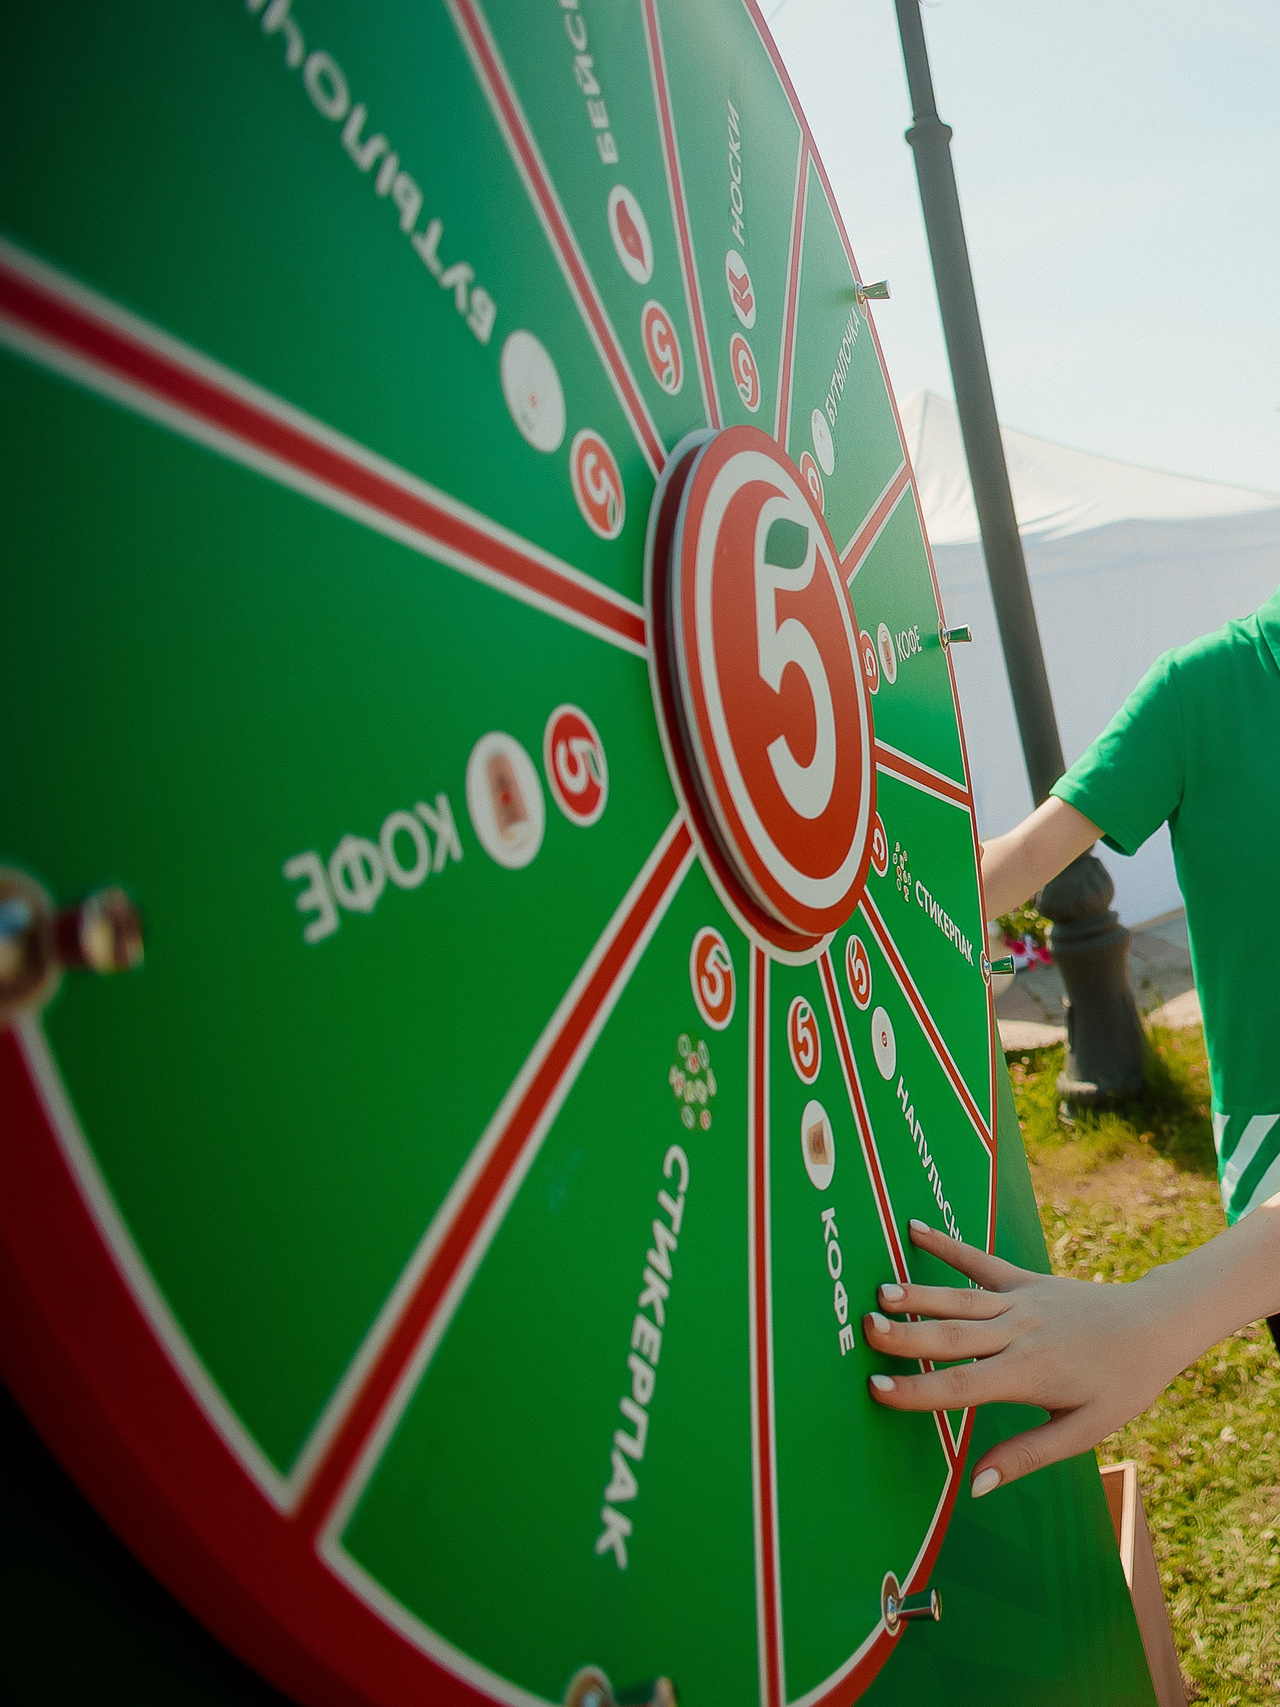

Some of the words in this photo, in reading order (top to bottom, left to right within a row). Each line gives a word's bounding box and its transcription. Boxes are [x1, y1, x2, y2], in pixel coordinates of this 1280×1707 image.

[560, 0, 619, 164] БЕЙС
[246, 0, 497, 345] БУТЫЛОЧ
[727, 98, 746, 247] НОСКИ
[824, 306, 861, 428] БУТЫЛОЧКА
[753, 496, 837, 820] 5
[895, 625, 922, 662] КОФЕ
[283, 792, 464, 944] КОФЕ
[915, 879, 974, 967] СТИКЕРПАК
[595, 1143, 690, 1571] СТИКЕРПАК
[820, 1206, 856, 1357] КОФЕ
